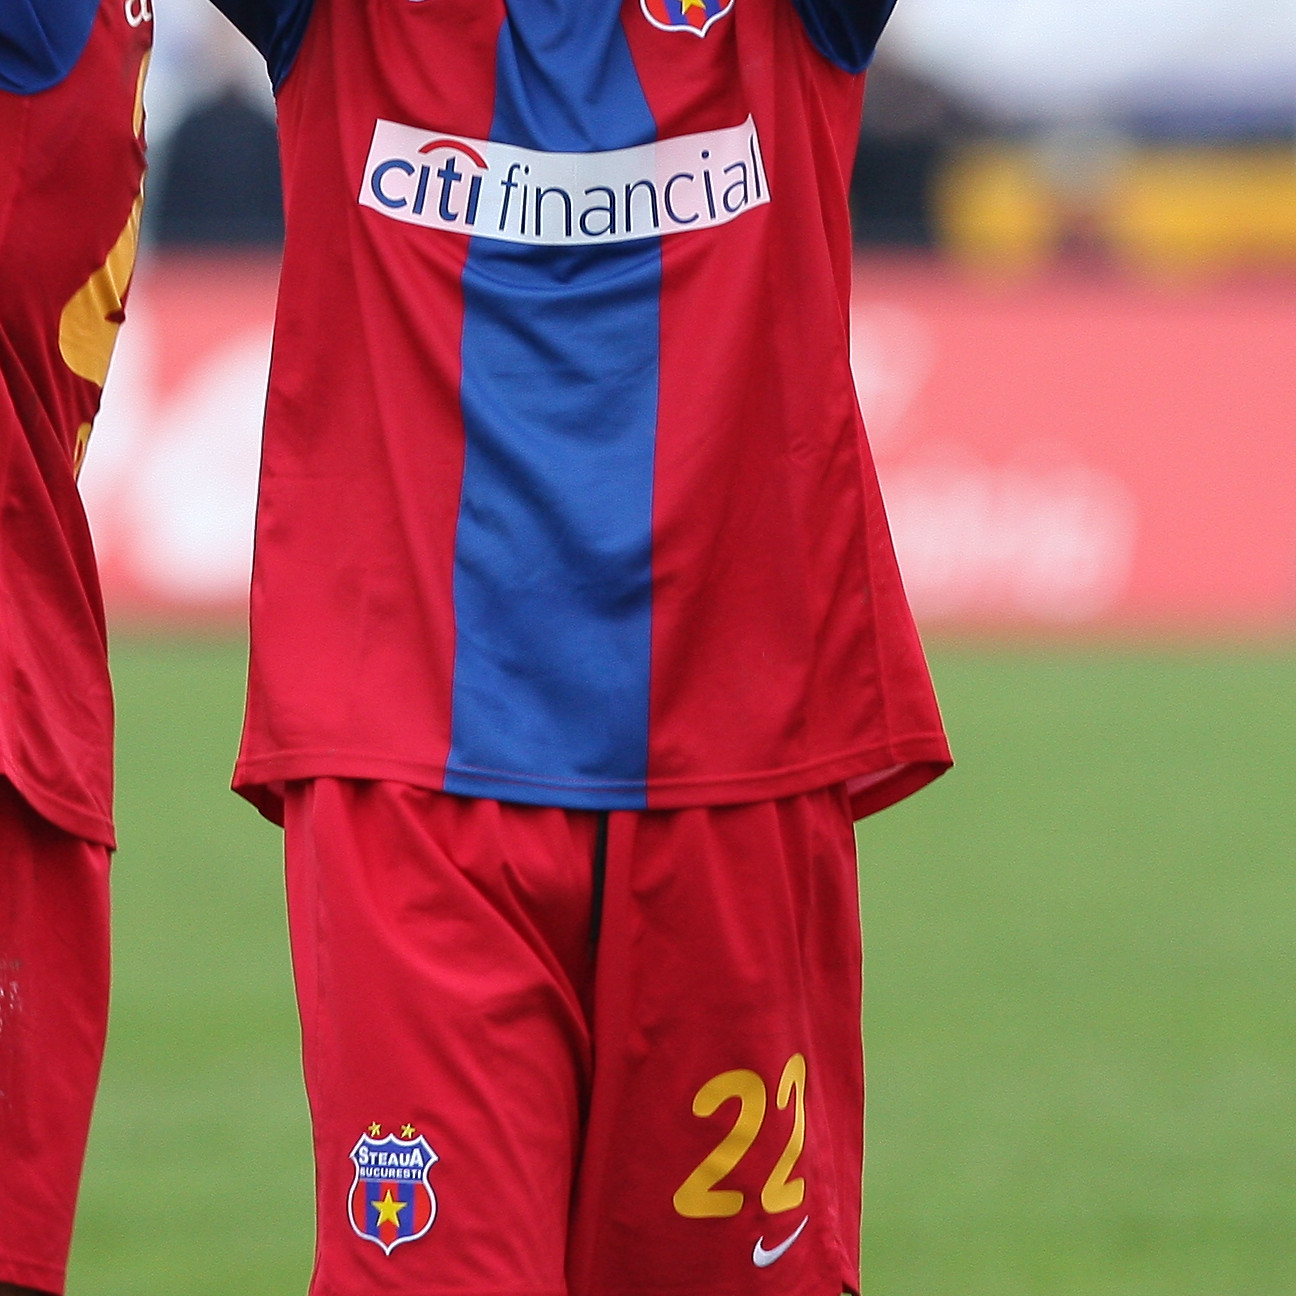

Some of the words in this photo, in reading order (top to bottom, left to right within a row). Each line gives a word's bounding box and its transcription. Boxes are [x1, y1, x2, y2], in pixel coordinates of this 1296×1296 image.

[499, 134, 763, 237] financial
[358, 1145, 424, 1167] STEAUA
[672, 1053, 806, 1218] 22
[360, 1166, 422, 1180] BUCURESTI
